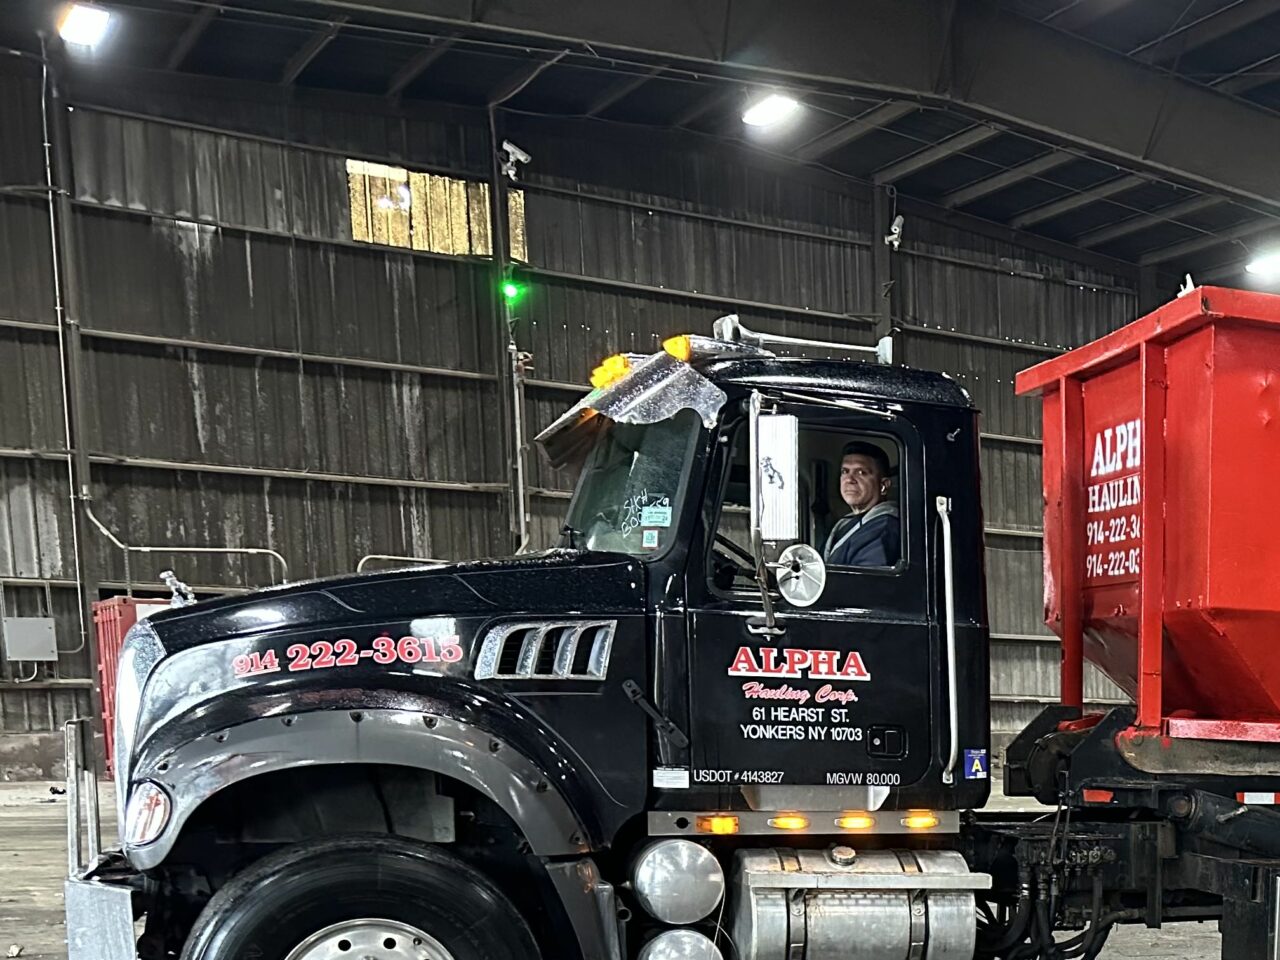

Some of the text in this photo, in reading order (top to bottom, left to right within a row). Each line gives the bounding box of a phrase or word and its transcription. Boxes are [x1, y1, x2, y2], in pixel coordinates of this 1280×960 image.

[232, 634, 464, 677] 914 222-3615
[728, 646, 871, 681] ALPHA
[742, 682, 858, 704] Hauling Corp.
[752, 707, 850, 723] 61 HEARST ST.
[740, 724, 863, 741] YONKERS NY 10703
[693, 769, 732, 783] USDOT
[826, 772, 900, 786] MGVW 80,000
